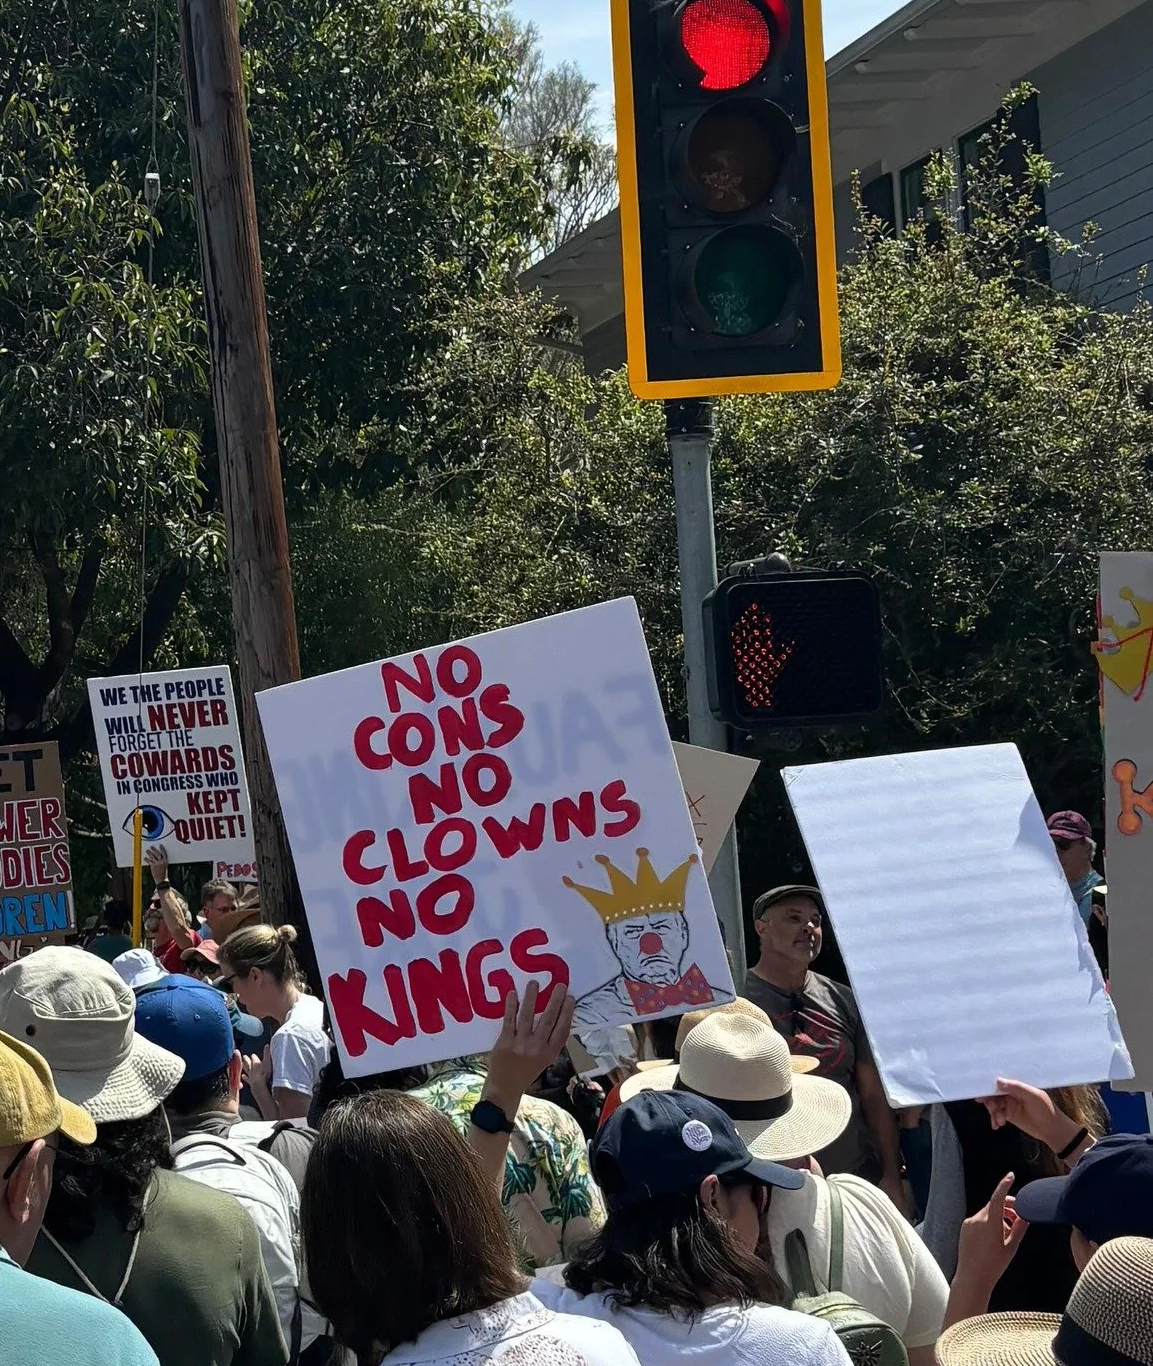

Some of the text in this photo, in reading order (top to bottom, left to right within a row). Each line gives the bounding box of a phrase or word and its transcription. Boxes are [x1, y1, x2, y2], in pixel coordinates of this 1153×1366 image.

[99, 677, 226, 706] WE THE PEOPLE
[381, 644, 483, 714] NO
[104, 699, 229, 736] WILL NEVER
[353, 683, 525, 771] CONS
[108, 729, 194, 753] FORGET THE
[110, 744, 236, 780] COWARDS
[116, 771, 239, 796] IN CONGRESS WHO
[186, 788, 241, 816] KEPT
[408, 752, 513, 825] NO
[174, 814, 247, 845] QUIET!
[342, 780, 642, 886] CLOWNS
[356, 873, 477, 948] NO
[328, 928, 571, 1058] KINGS
